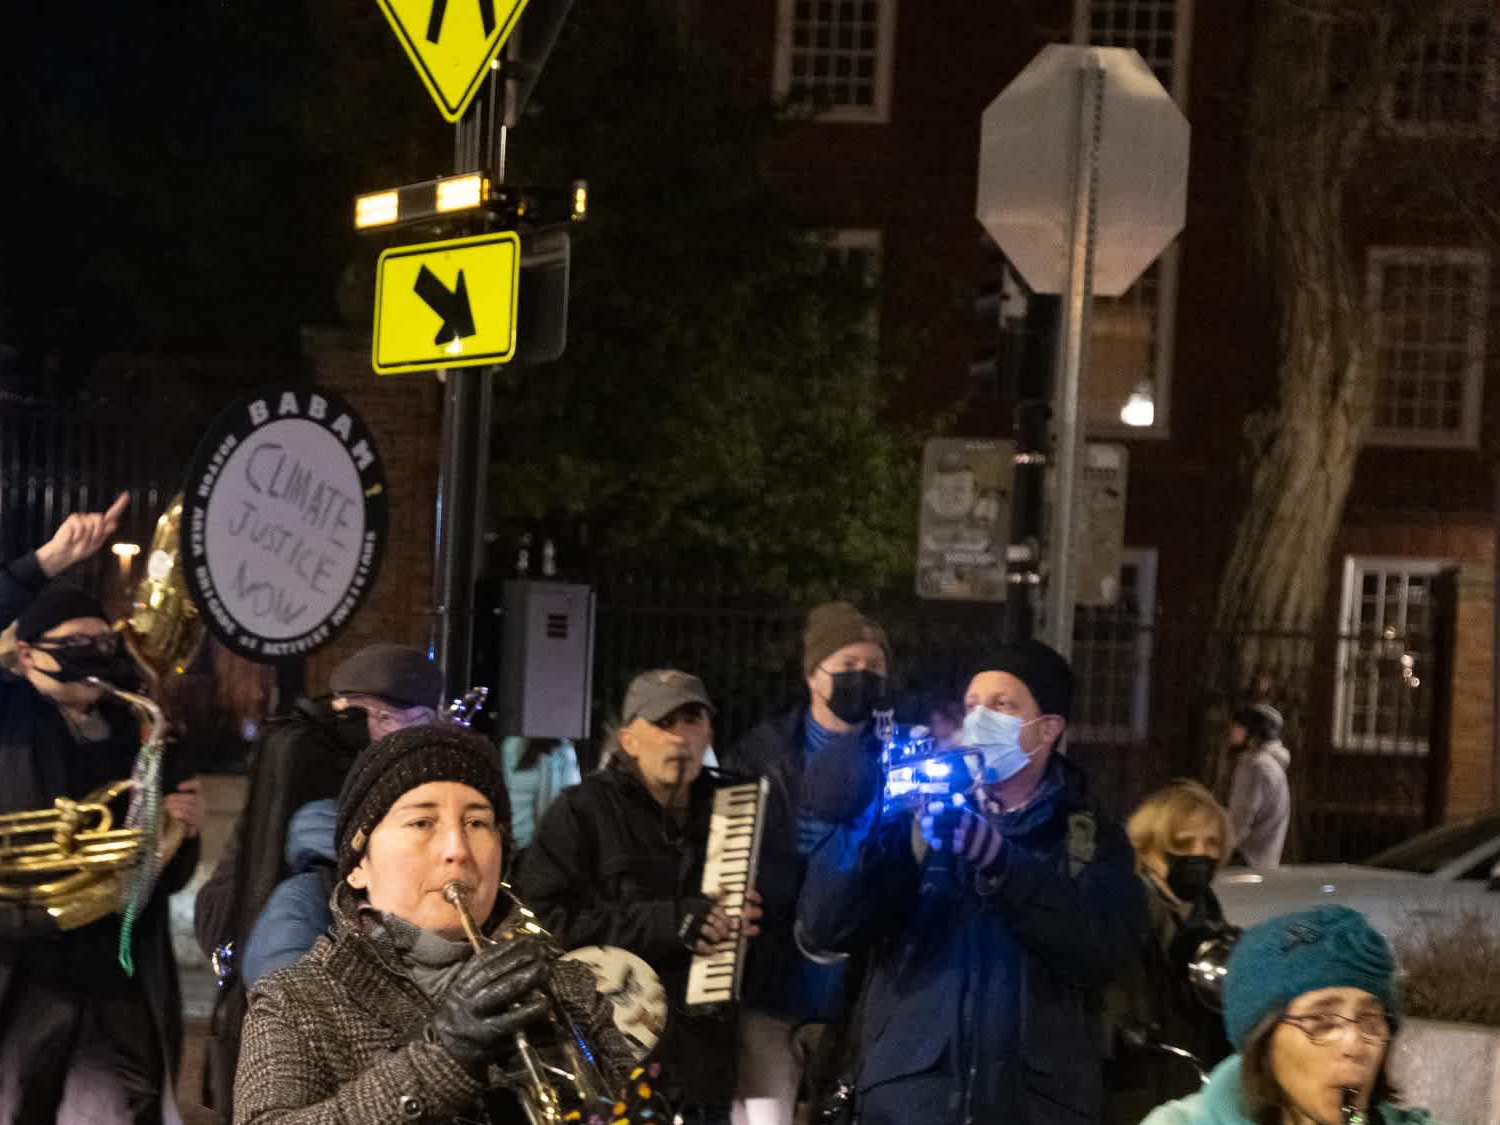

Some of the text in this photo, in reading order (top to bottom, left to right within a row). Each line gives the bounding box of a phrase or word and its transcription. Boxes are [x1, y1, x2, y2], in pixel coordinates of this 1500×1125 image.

[197, 433, 238, 498] BOSTON
[245, 442, 355, 549] CLIMATE
[190, 507, 206, 557] AREA
[228, 500, 339, 595] JUSTICE
[233, 559, 308, 625] NOW
[331, 530, 377, 627] MUSICIANS
[261, 623, 331, 656] ACTIVIST
